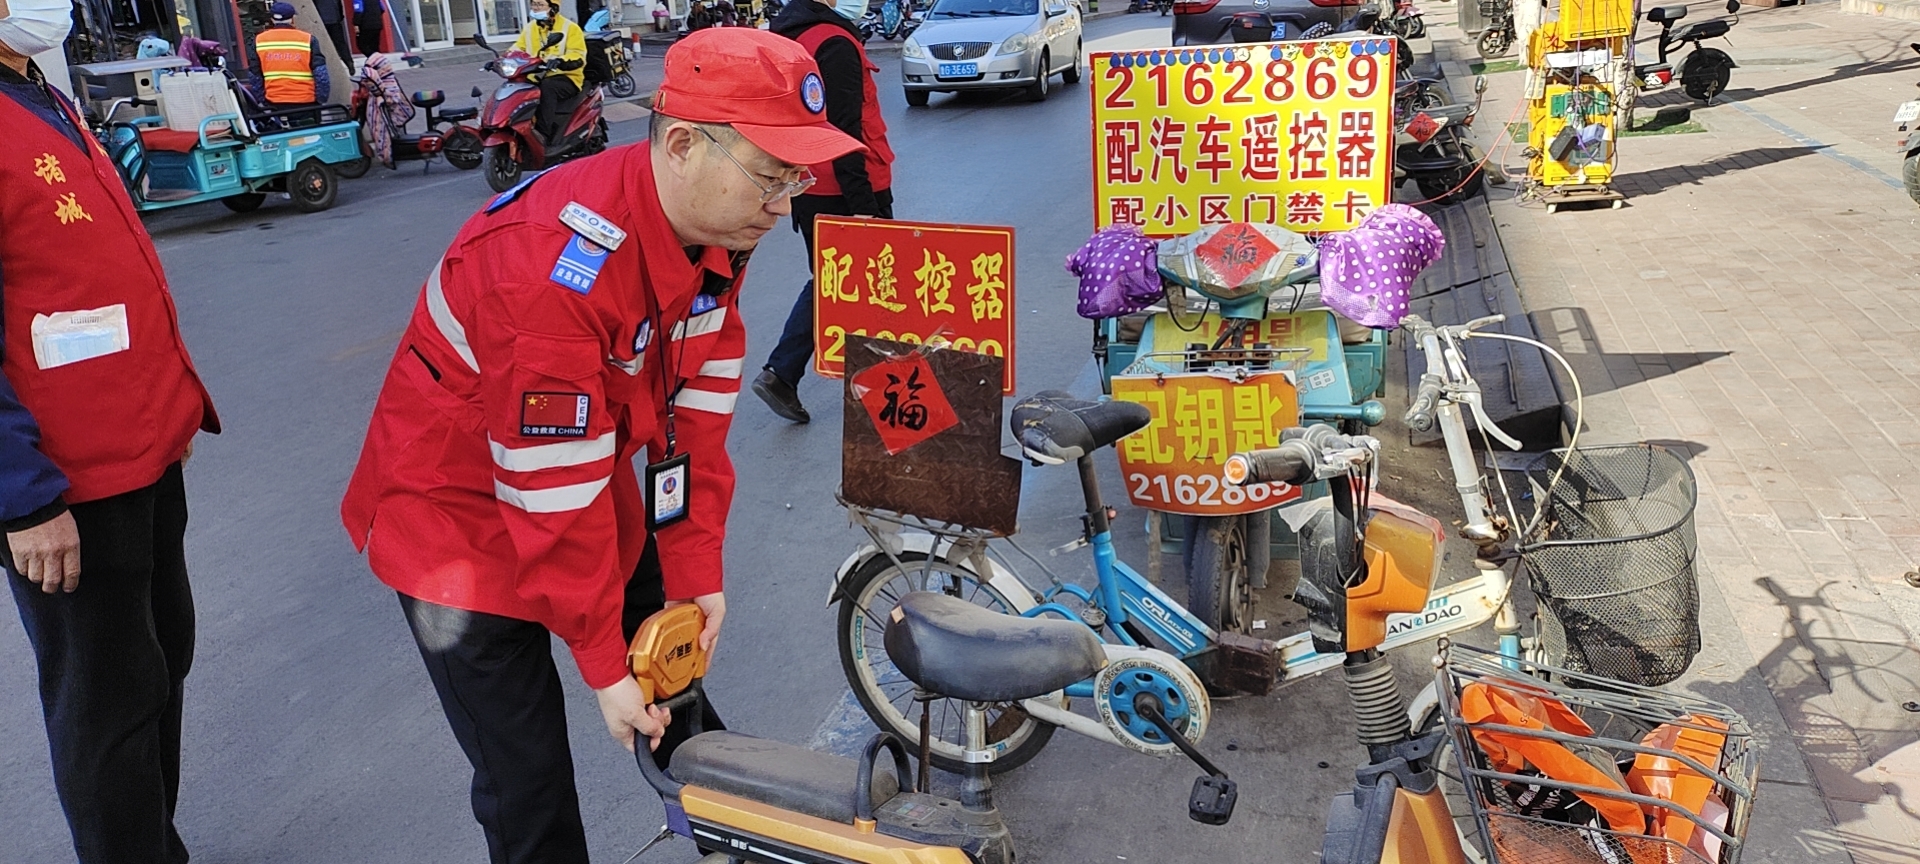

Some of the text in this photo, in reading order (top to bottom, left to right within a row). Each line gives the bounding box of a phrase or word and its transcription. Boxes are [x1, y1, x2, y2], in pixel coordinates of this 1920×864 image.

[1105, 54, 1379, 108] 2162869
[1105, 111, 1376, 185] 配汽车遥控器
[1110, 190, 1371, 226] 配小区门禁卡
[879, 366, 928, 432] 福
[1118, 383, 1284, 466] 配钥匙
[558, 427, 584, 435] CHINA
[1425, 605, 1462, 624] DAO
